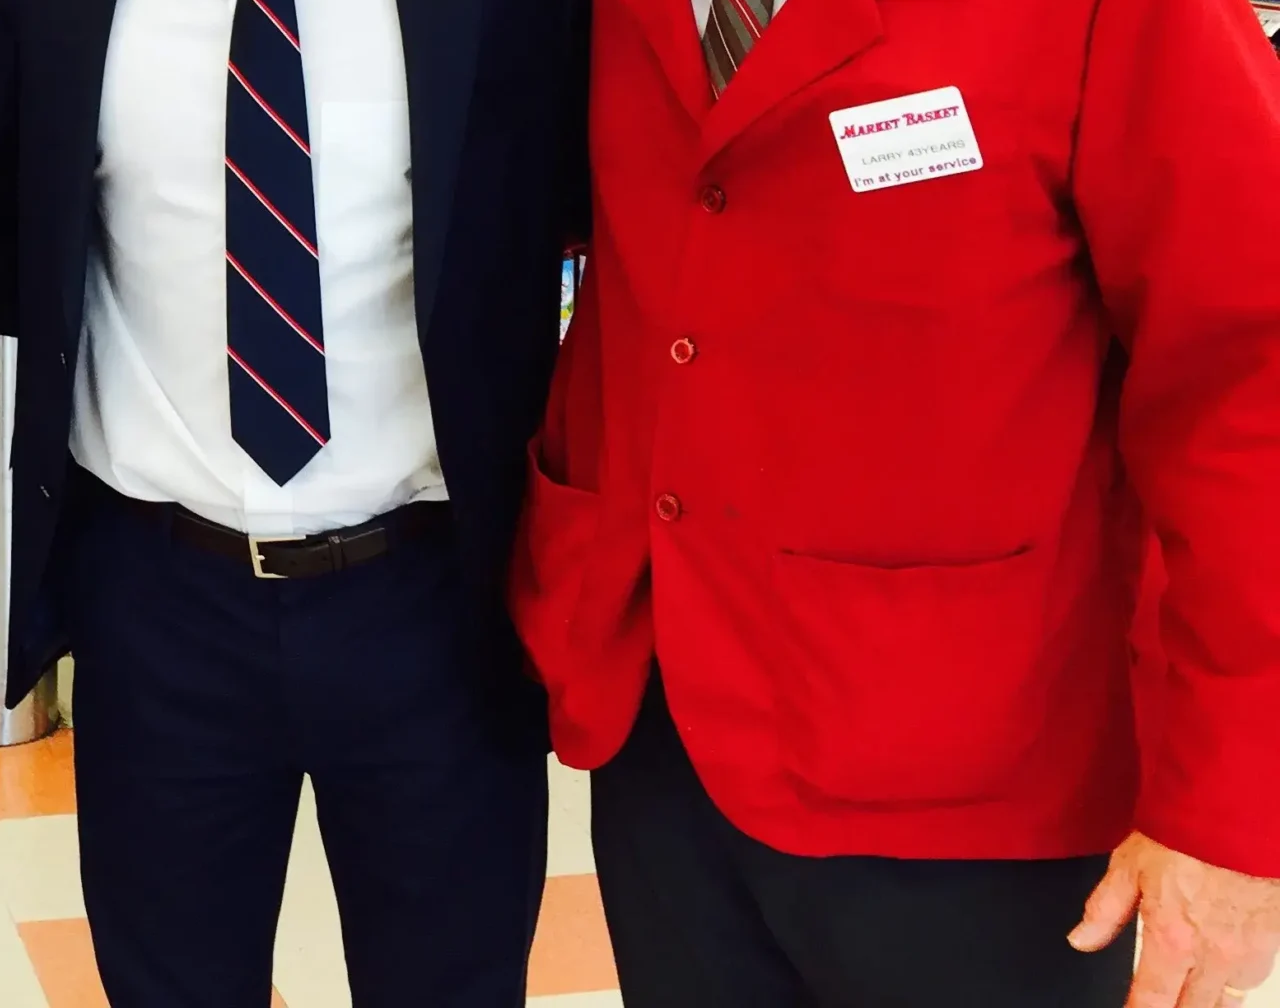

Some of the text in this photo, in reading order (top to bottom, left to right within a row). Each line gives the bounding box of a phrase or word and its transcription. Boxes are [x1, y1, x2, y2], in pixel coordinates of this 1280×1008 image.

[840, 106, 959, 140] MARKET BASKET
[854, 156, 977, 187] I'm at your service
[861, 150, 903, 166] LARRY
